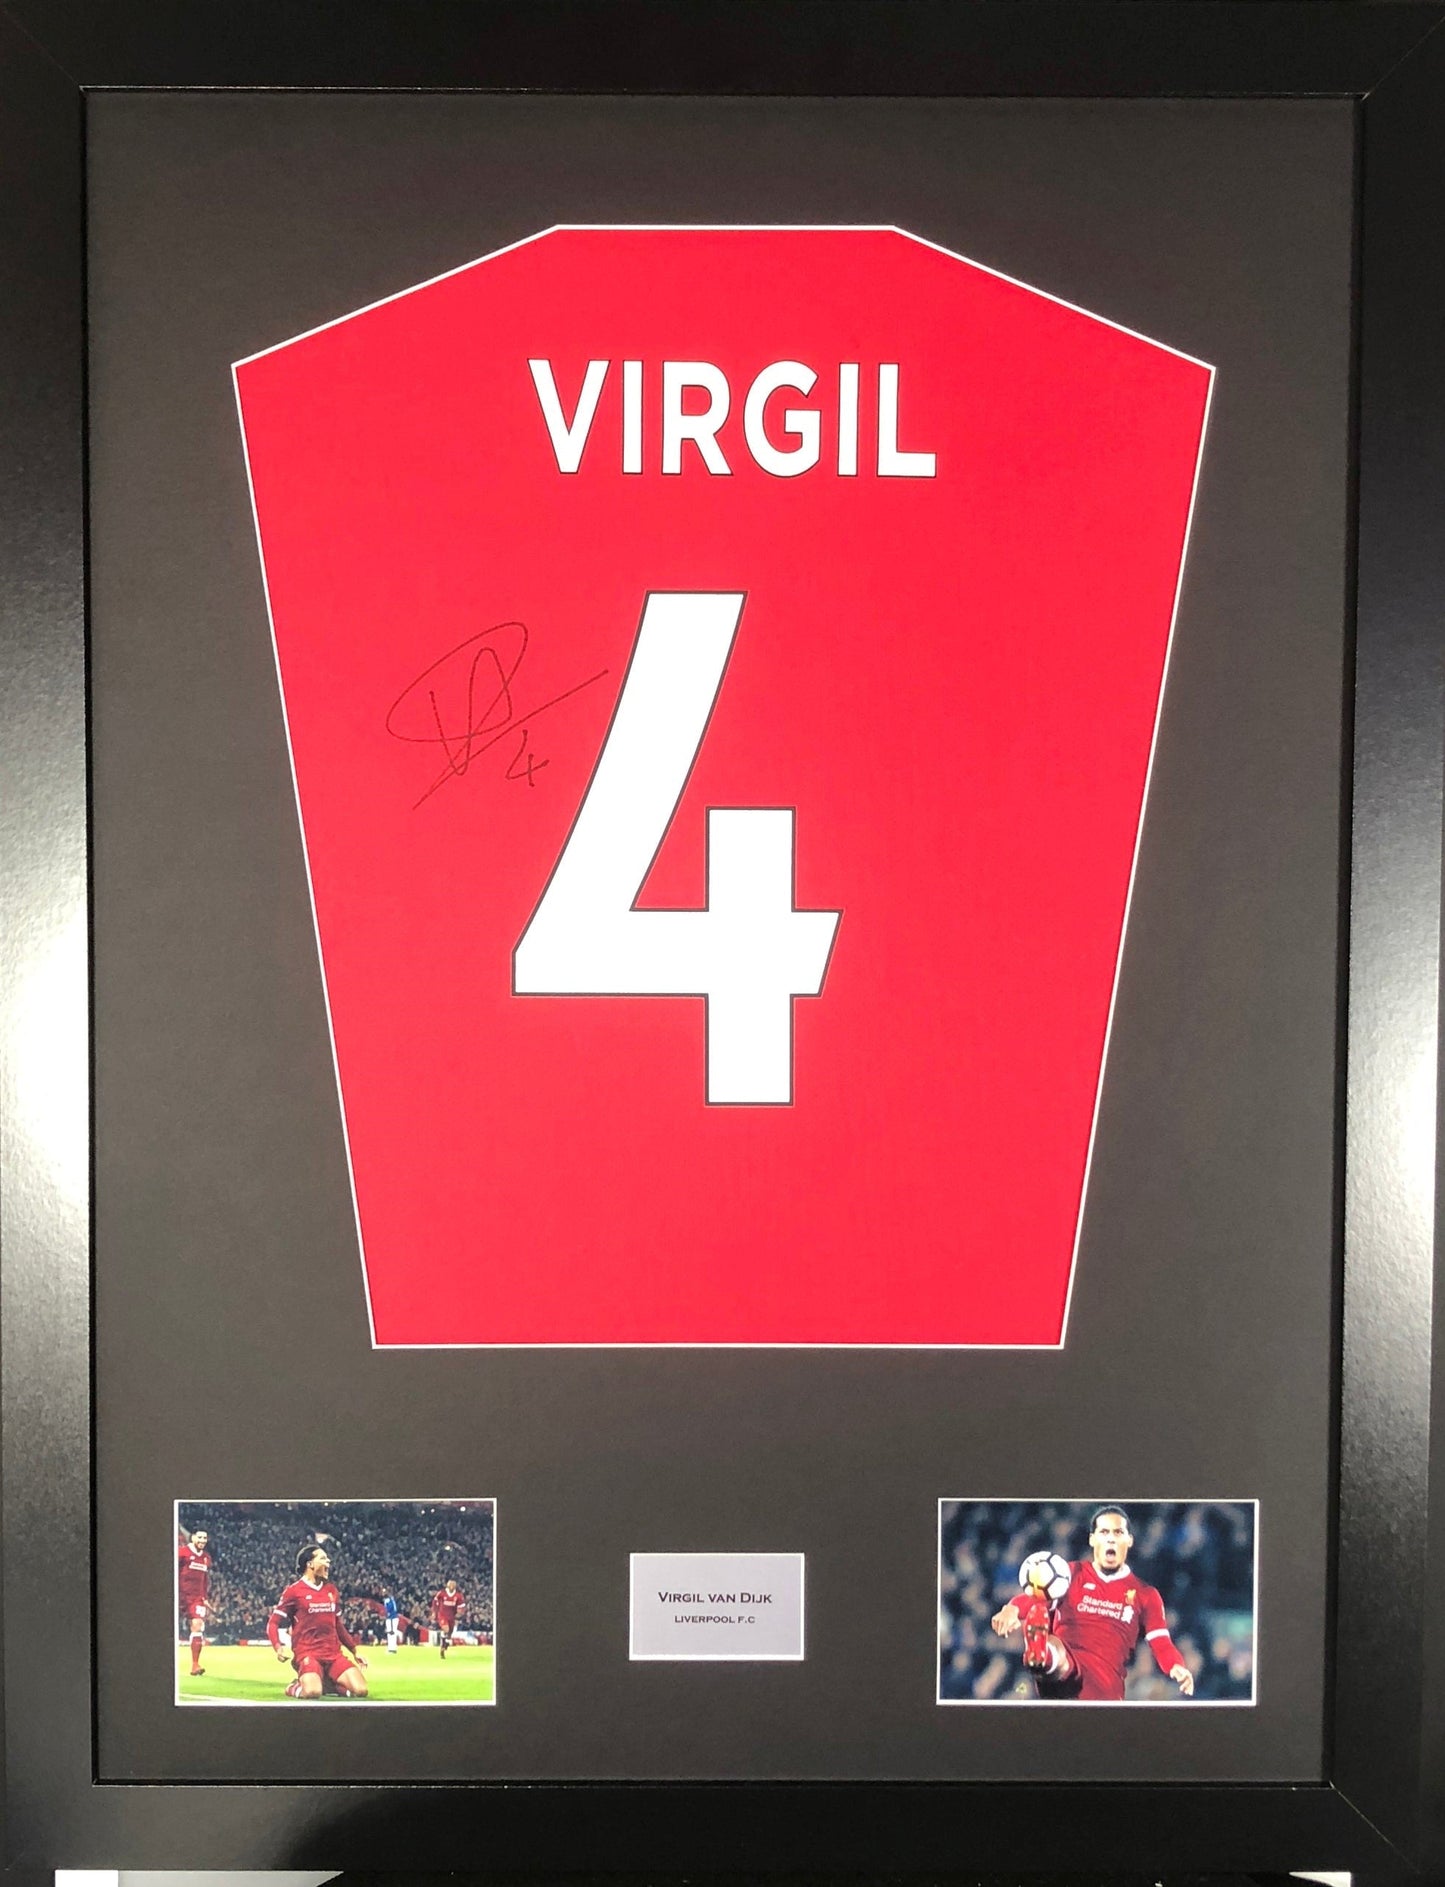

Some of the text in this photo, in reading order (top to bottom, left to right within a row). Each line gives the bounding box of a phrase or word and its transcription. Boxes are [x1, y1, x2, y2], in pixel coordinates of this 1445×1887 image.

[527, 358, 937, 478] VIRGIL
[505, 729, 550, 787] 4
[512, 590, 843, 1105] 4
[1077, 1603, 1120, 1619] Chartered
[1082, 1595, 1122, 1610] Standard
